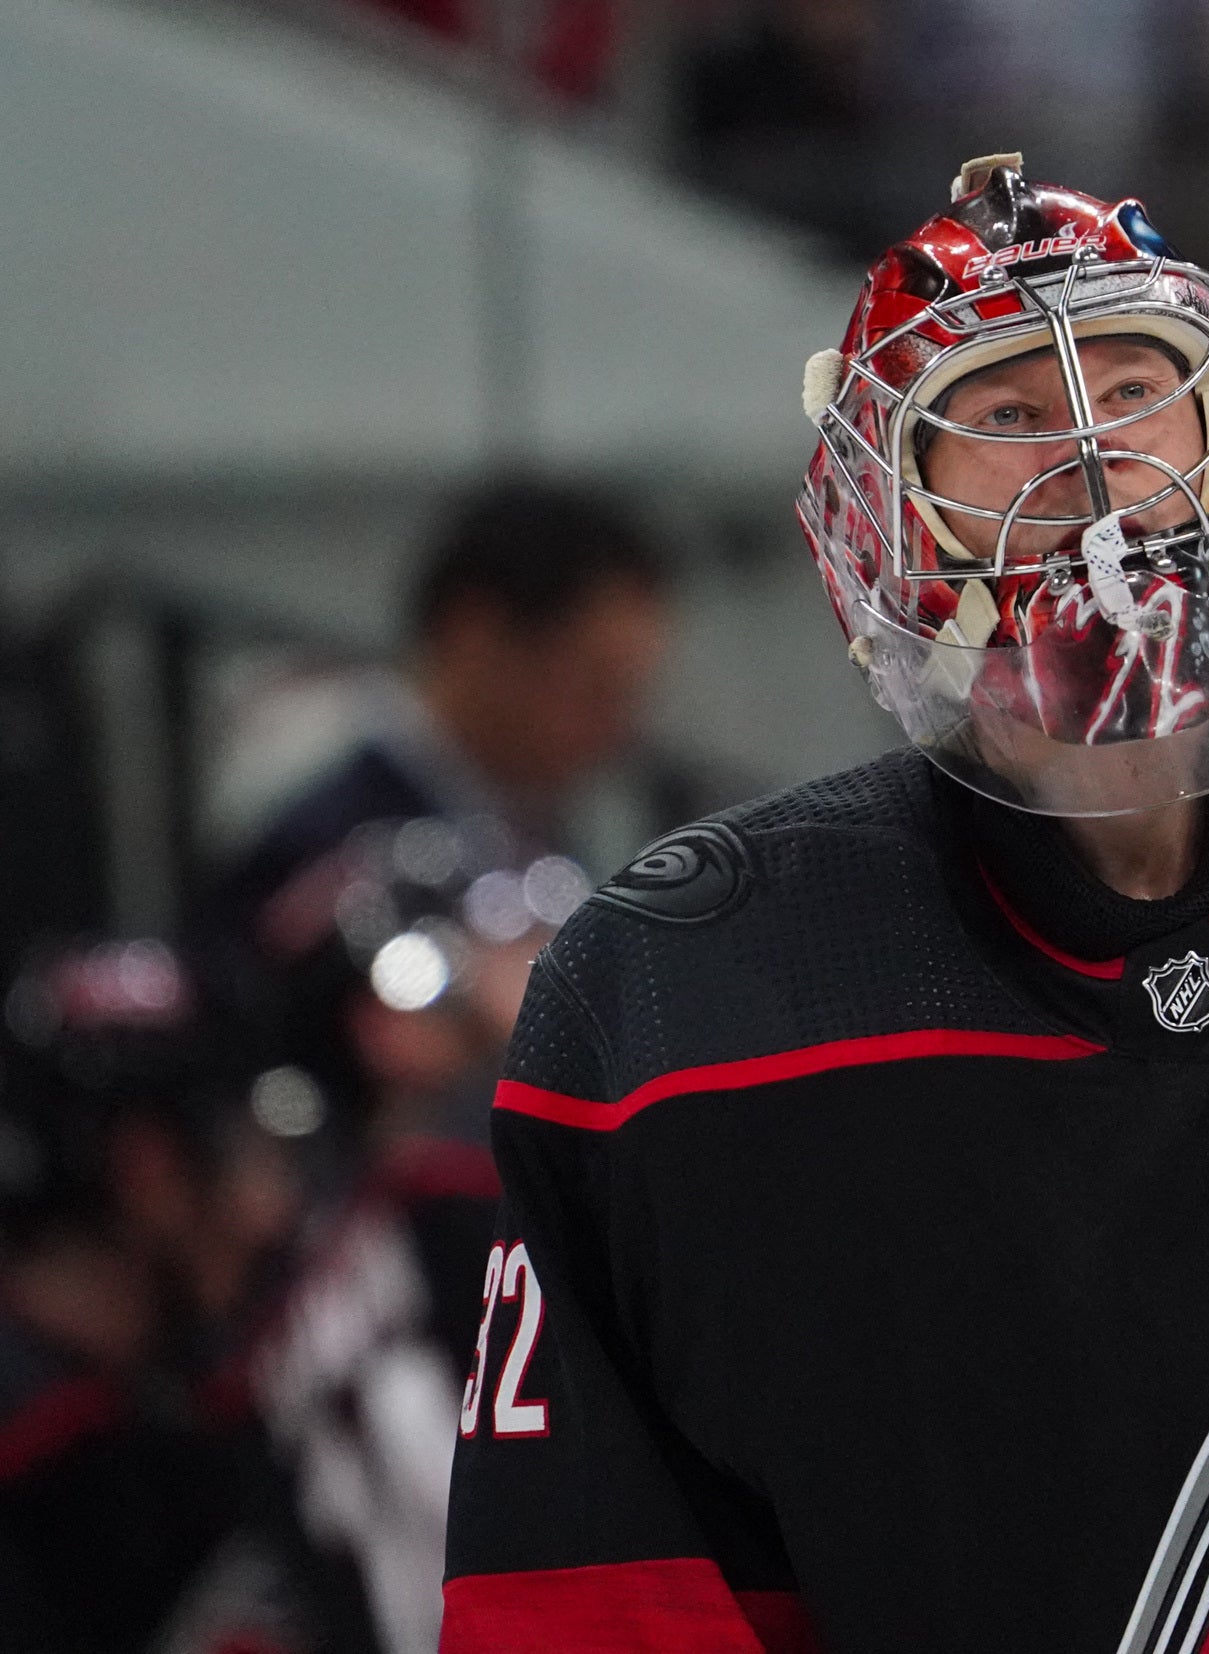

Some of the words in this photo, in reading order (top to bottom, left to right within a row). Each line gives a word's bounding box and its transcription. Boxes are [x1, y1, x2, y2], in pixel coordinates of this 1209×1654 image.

[962, 233, 1107, 279] BAUER
[1170, 972, 1201, 1020] NHL
[460, 1238, 551, 1440] 32
